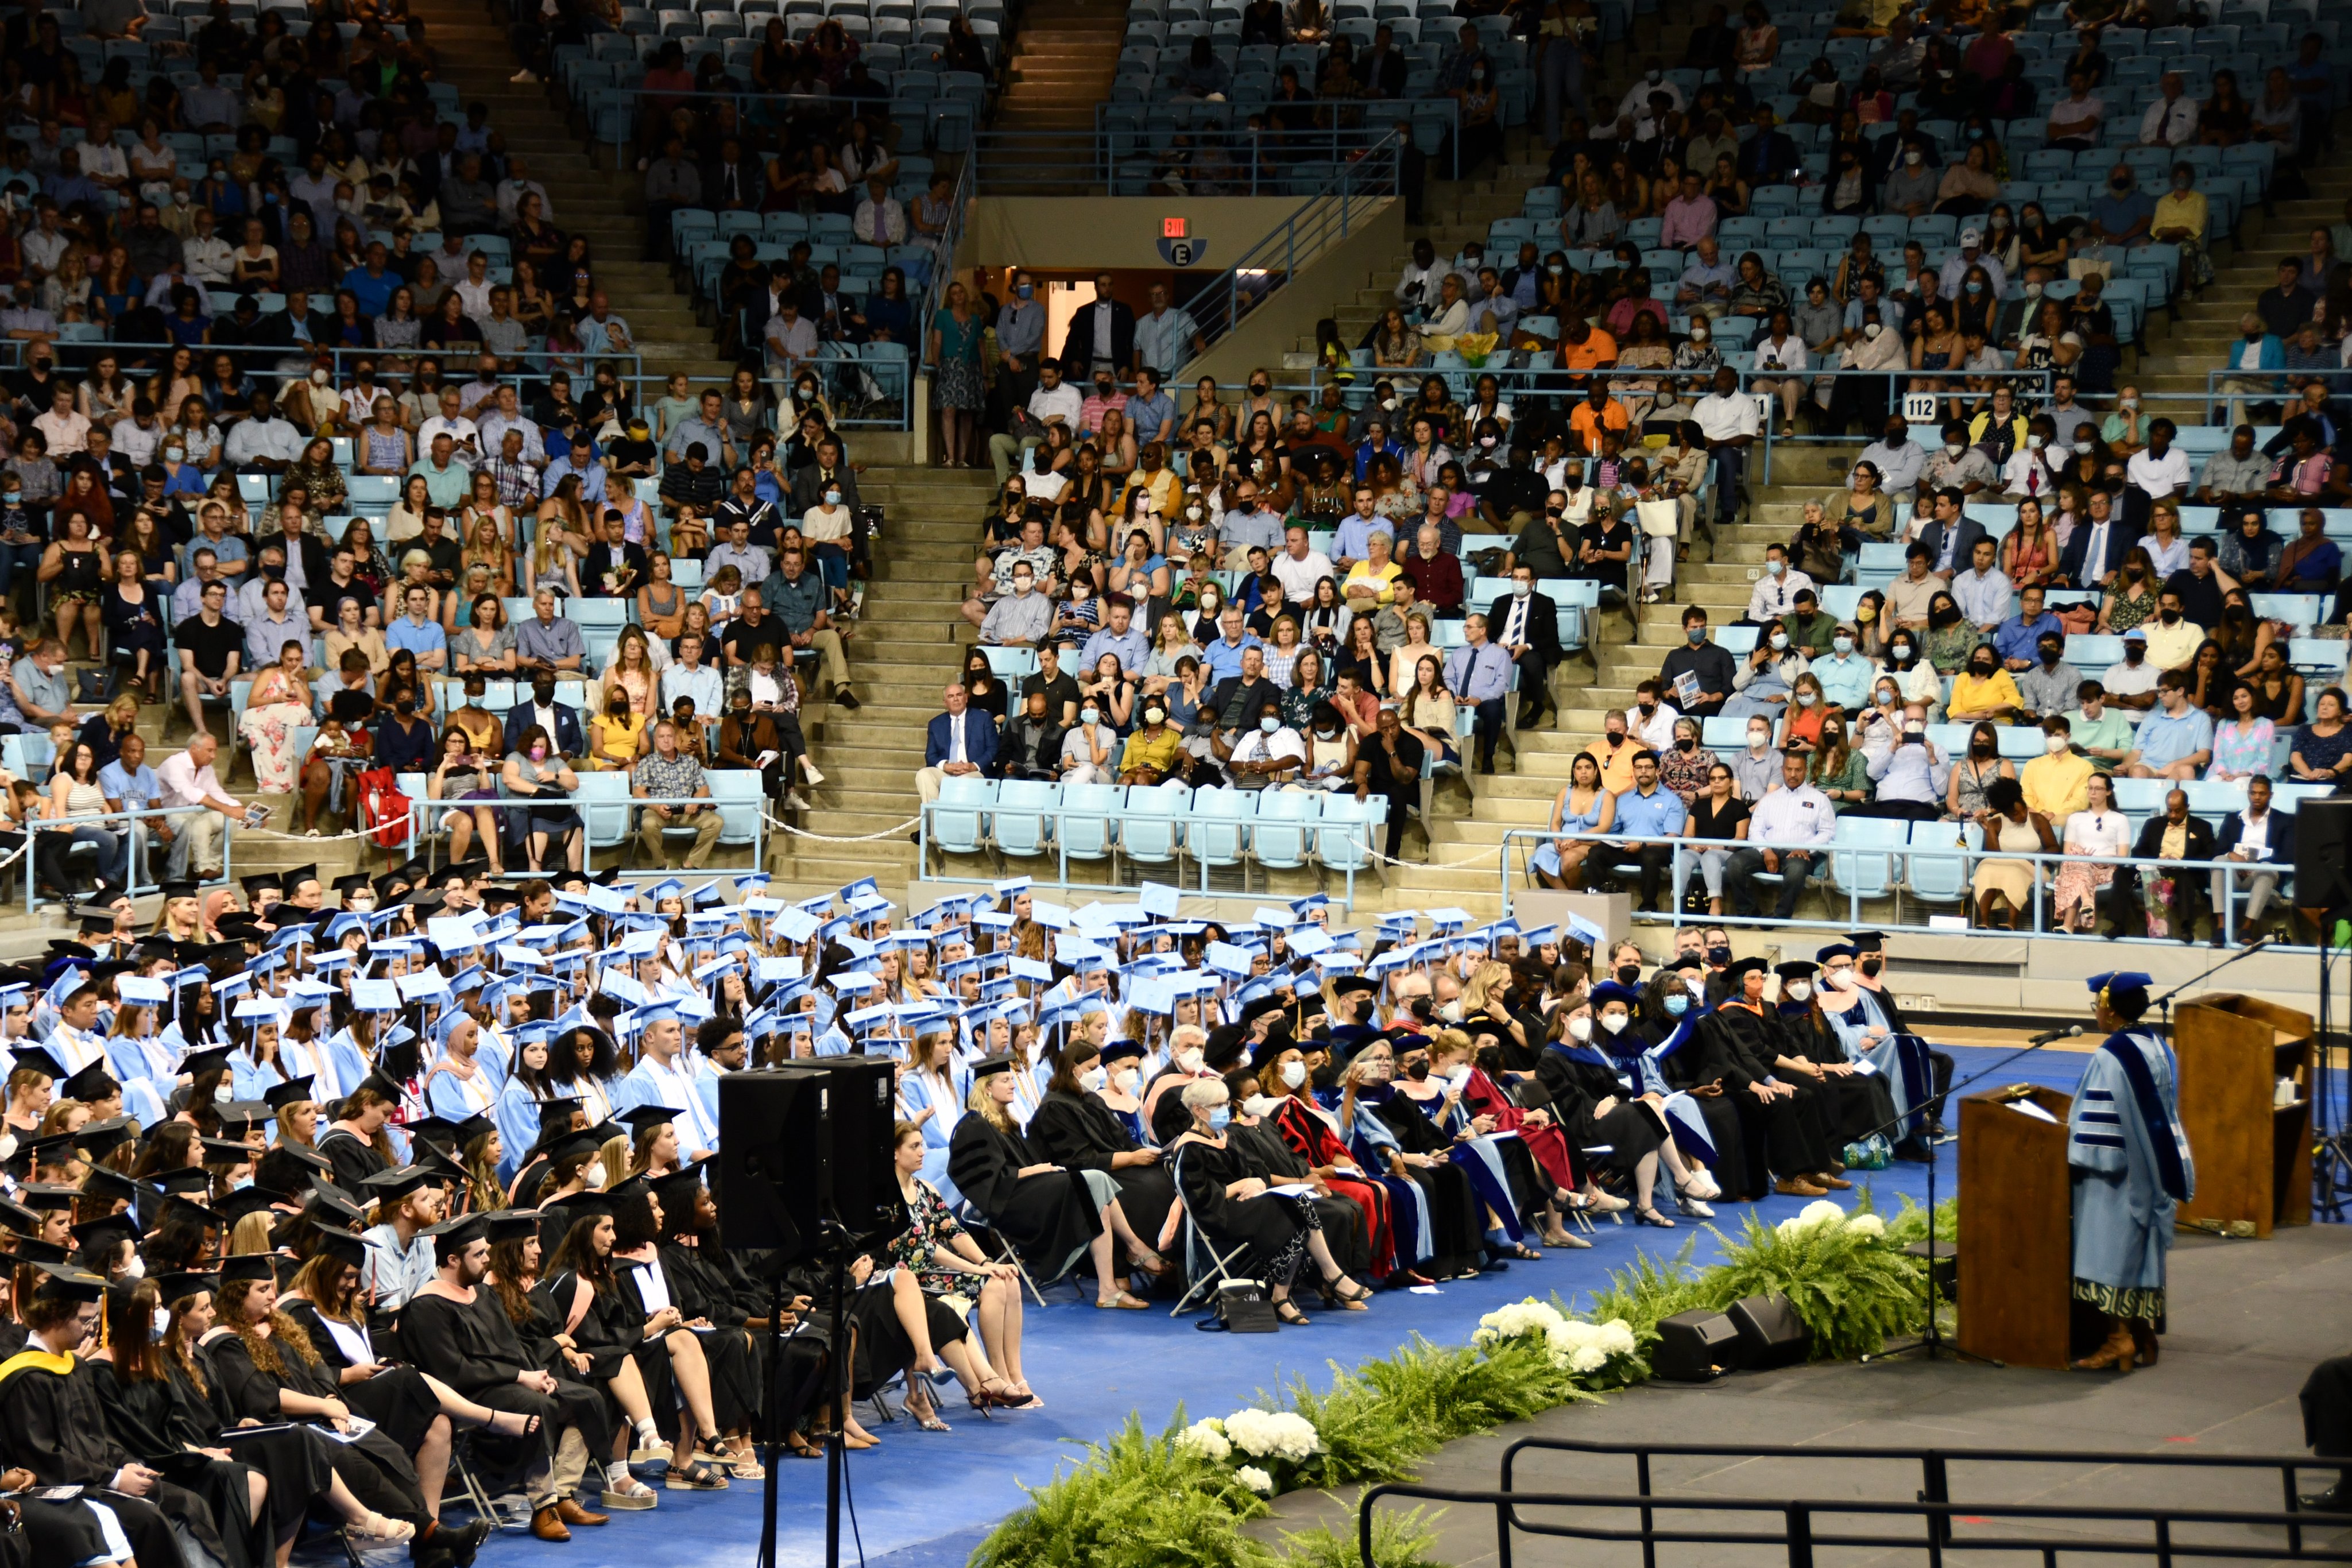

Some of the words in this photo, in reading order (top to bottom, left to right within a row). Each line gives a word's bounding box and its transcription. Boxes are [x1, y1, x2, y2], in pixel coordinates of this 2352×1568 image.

[1165, 218, 1185, 237] EXIT
[1175, 247, 1187, 264] E
[1908, 399, 1933, 416] 112
